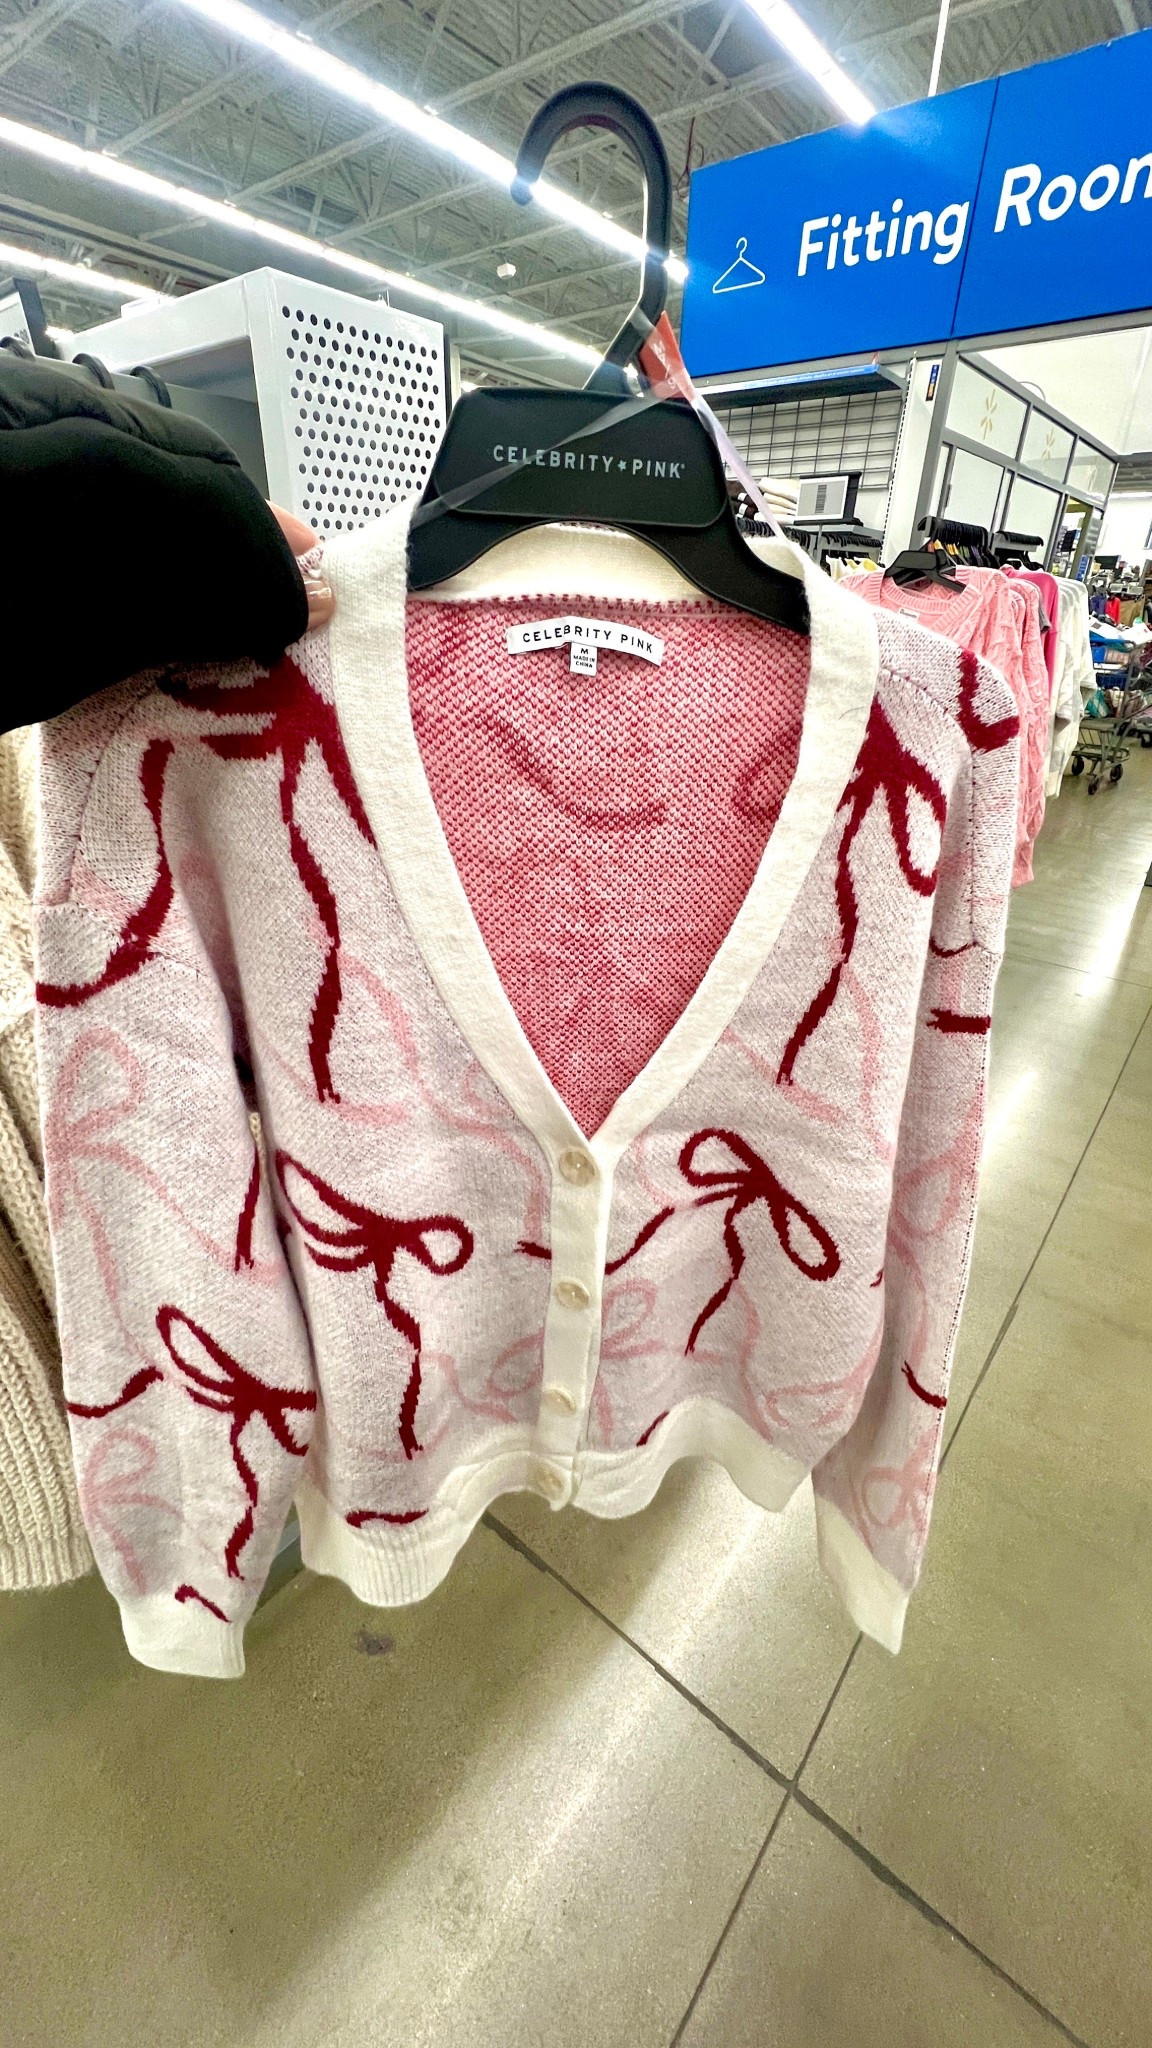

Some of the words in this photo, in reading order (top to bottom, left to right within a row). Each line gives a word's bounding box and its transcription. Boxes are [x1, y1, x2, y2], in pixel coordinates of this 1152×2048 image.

[797, 198, 970, 277] Fitting
[493, 444, 614, 473] CELEBRITY
[632, 458, 681, 479] PINK
[522, 624, 612, 643] CELEBRITY
[620, 633, 653, 654] PINK
[580, 647, 589, 655] M
[575, 660, 593, 668] CHINA
